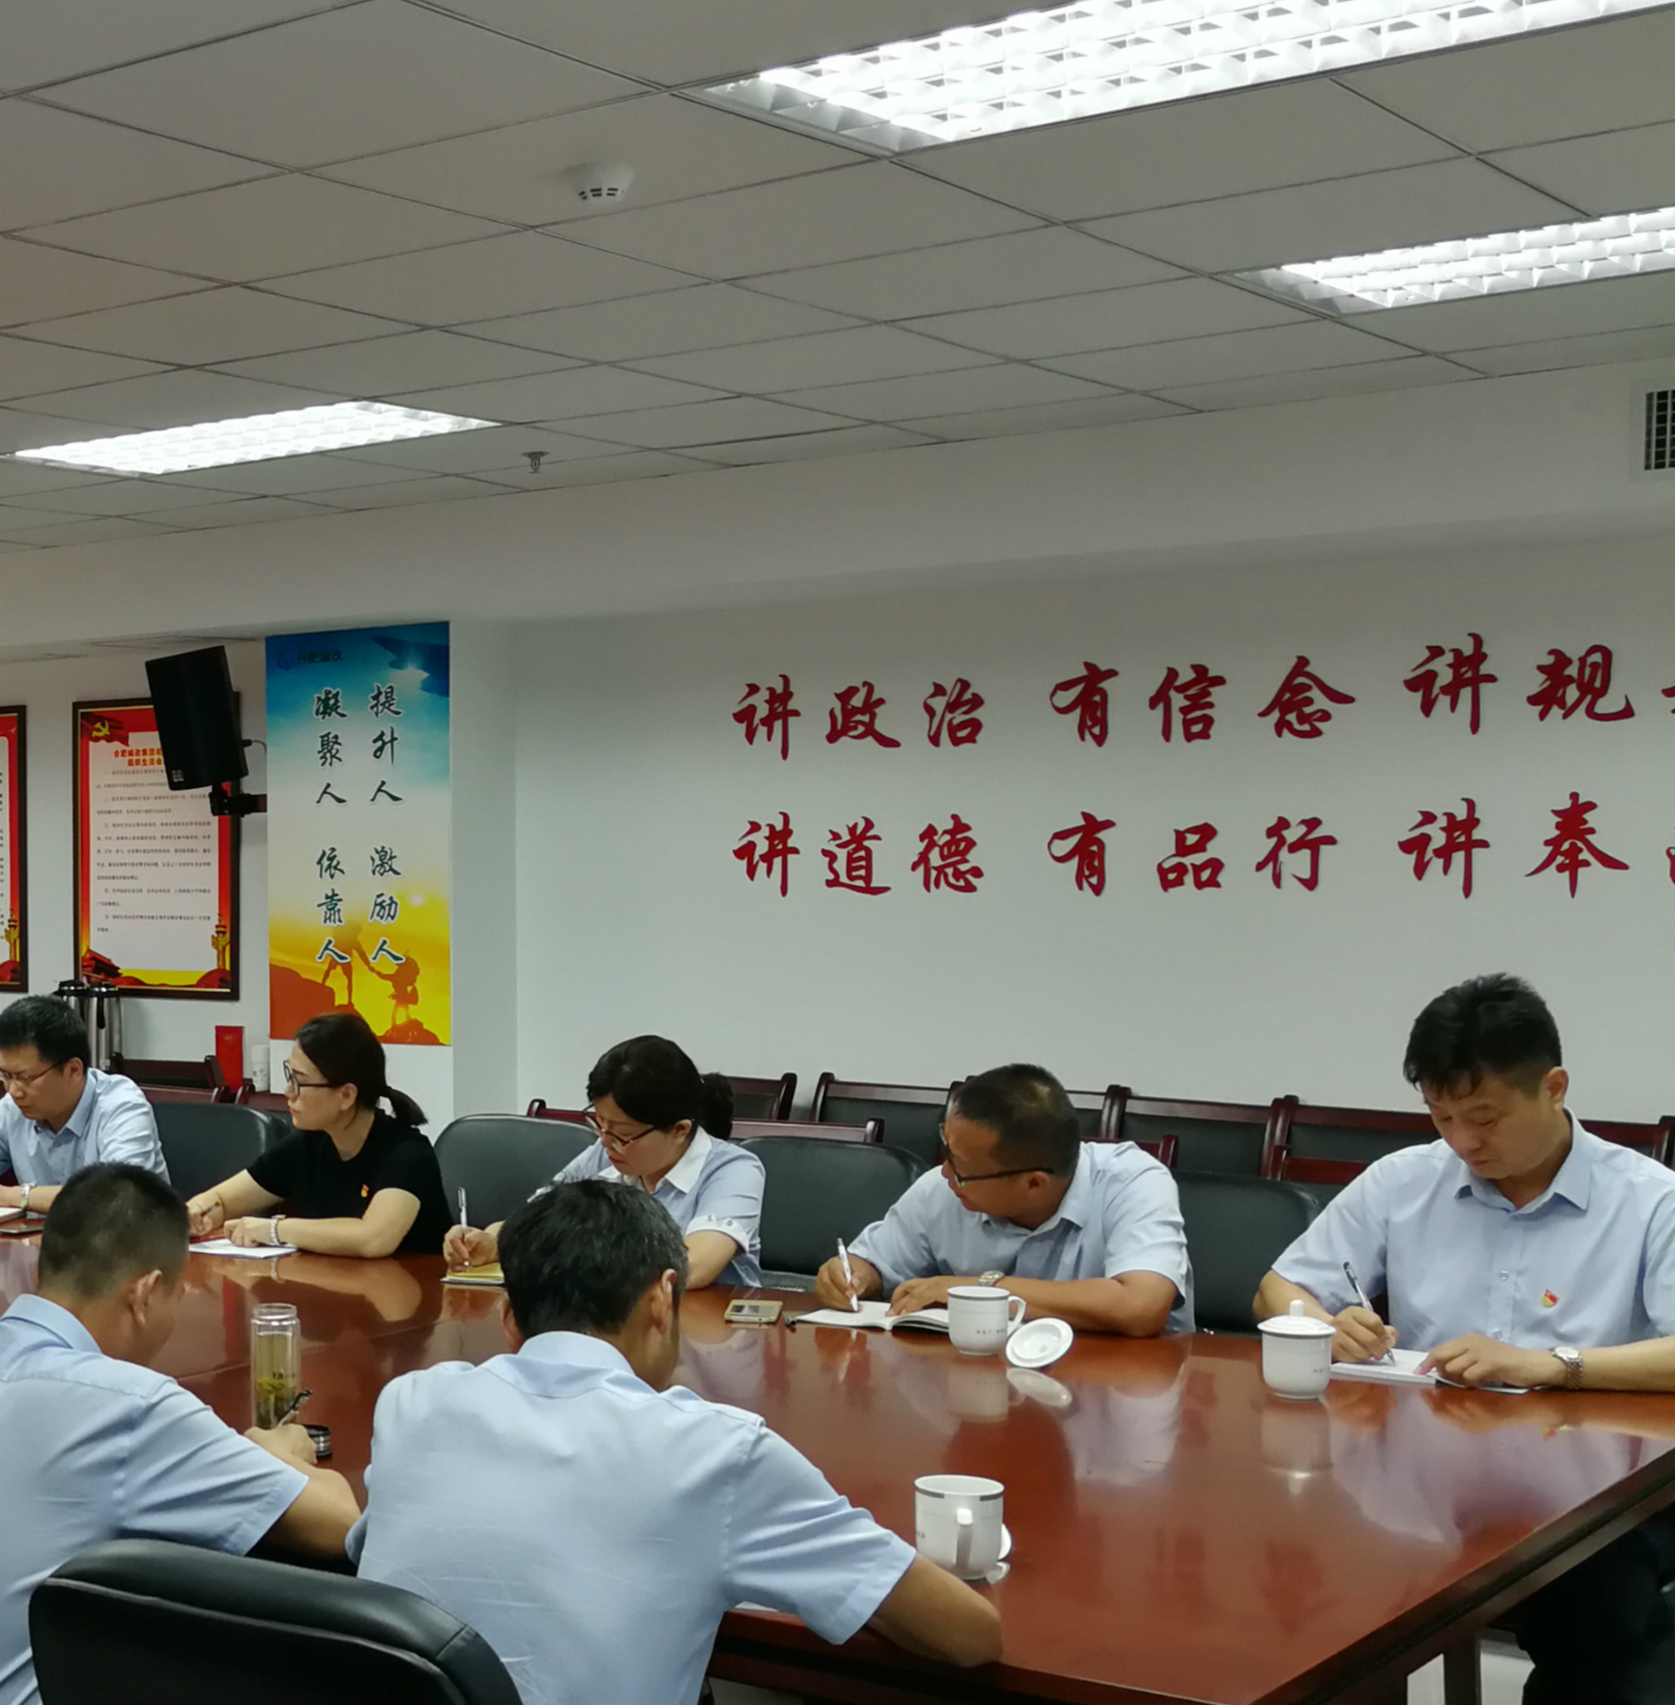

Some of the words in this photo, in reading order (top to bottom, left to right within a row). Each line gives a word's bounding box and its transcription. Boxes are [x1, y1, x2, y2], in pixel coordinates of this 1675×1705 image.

[314, 688, 348, 805] 凝聚人
[368, 684, 403, 803] 提升人
[732, 674, 985, 761] 讲政治
[1051, 656, 1356, 747] 有信念
[1403, 633, 1675, 736] 讲规
[731, 811, 984, 898] 讲道德
[1046, 811, 1338, 897] 有品行
[1397, 792, 1675, 898] 讲奉
[316, 846, 350, 962] 依靠人
[371, 845, 405, 963] 激励人
